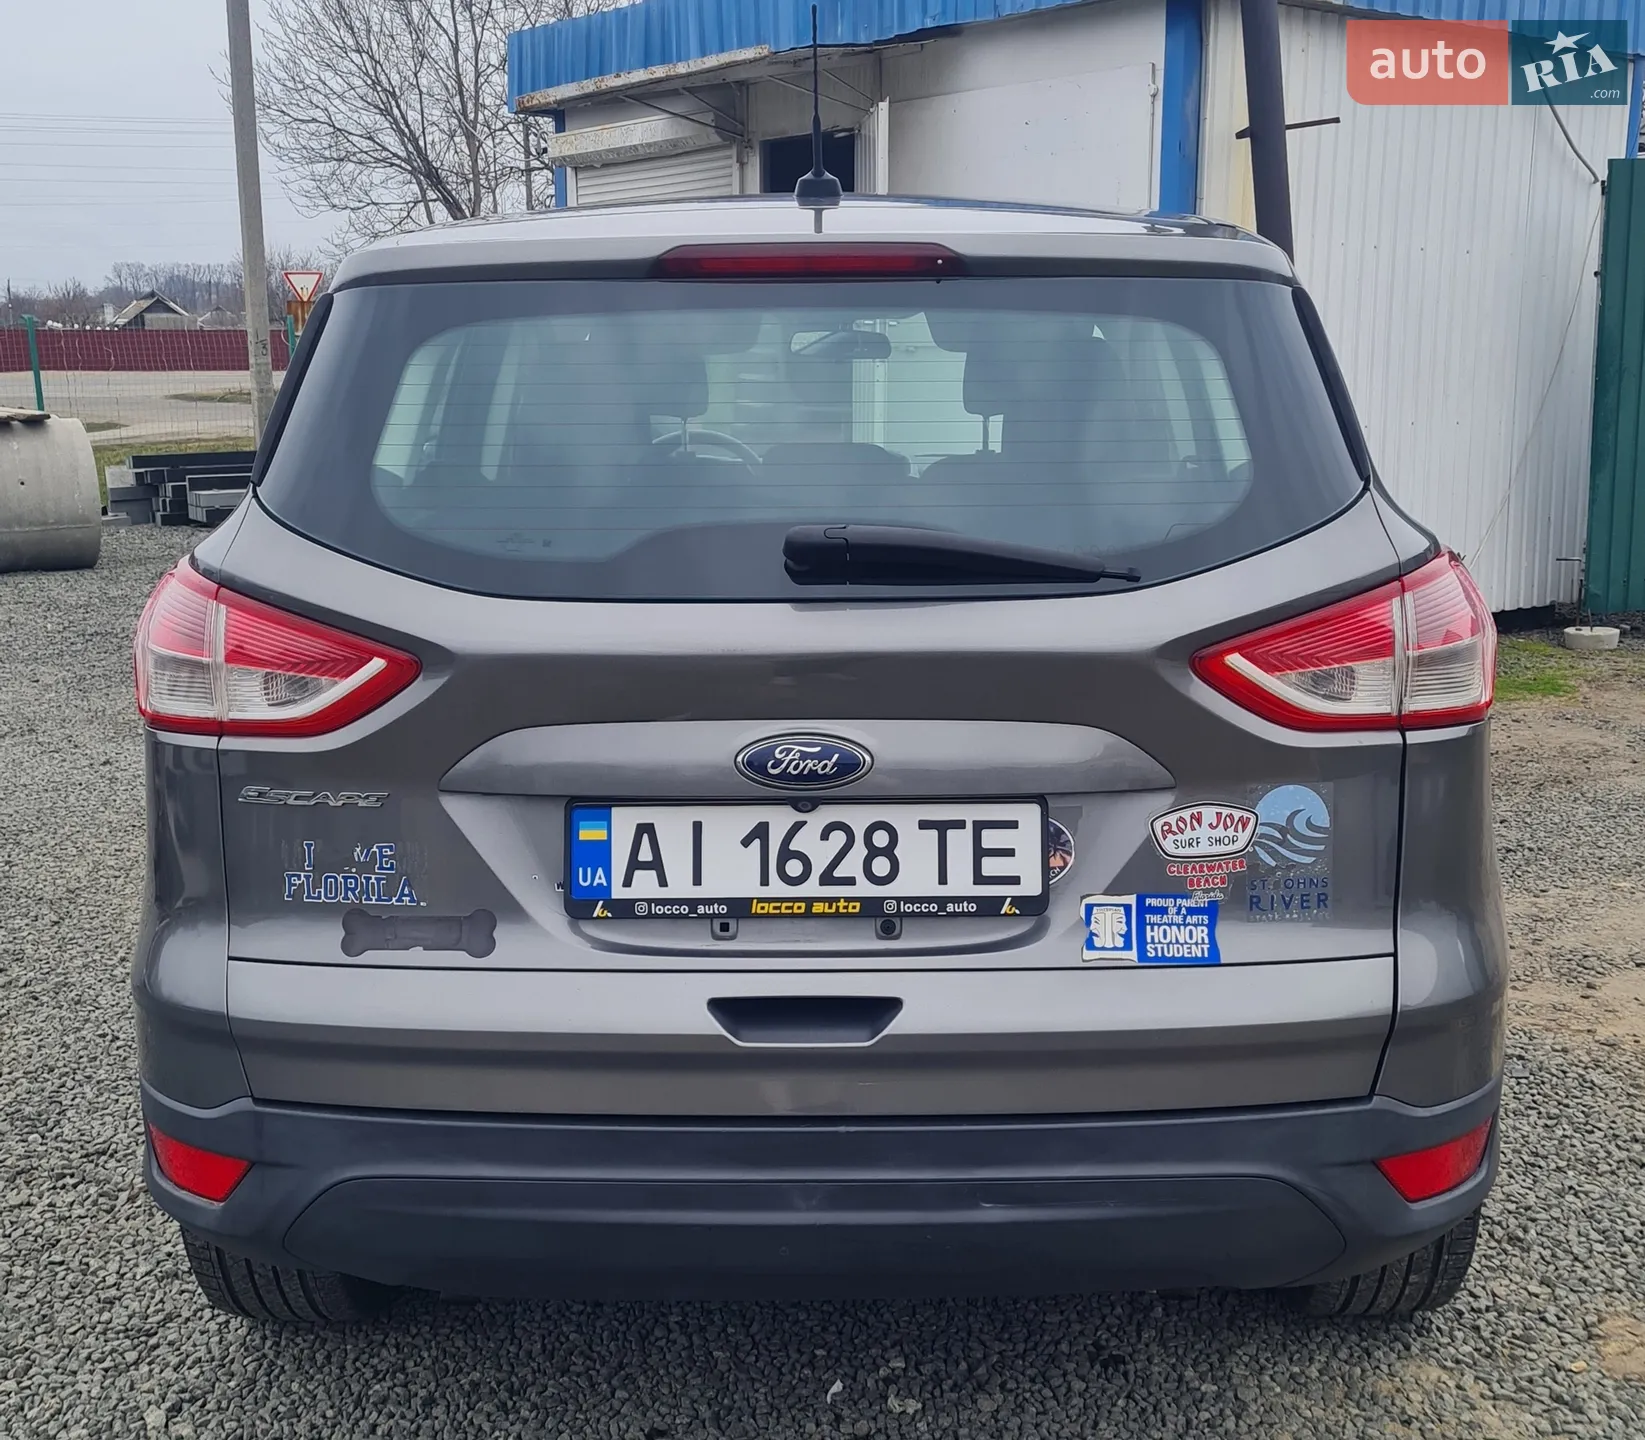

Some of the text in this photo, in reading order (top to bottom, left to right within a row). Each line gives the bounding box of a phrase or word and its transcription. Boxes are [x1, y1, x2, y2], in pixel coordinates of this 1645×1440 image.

[766, 744, 840, 775] Ford
[1160, 811, 1251, 841] RON JON
[1172, 834, 1239, 850] SURF SHOP
[621, 818, 1022, 888] AI 1628 TE
[1167, 859, 1247, 876] CLEARWATER
[578, 866, 608, 887] UA
[1186, 875, 1228, 890] BEACH
[1282, 877, 1329, 890] OHNS
[651, 903, 728, 917] locco_auto
[751, 898, 861, 914] locco auto
[900, 900, 977, 915] locco_auto
[1145, 898, 1175, 907] PROUD
[1249, 892, 1329, 912] RIVER
[1167, 906, 1187, 915] OF A
[1145, 914, 1209, 924] THEATRE ARTS
[1146, 925, 1209, 944] HONOR
[1147, 944, 1210, 958] STUDENT
